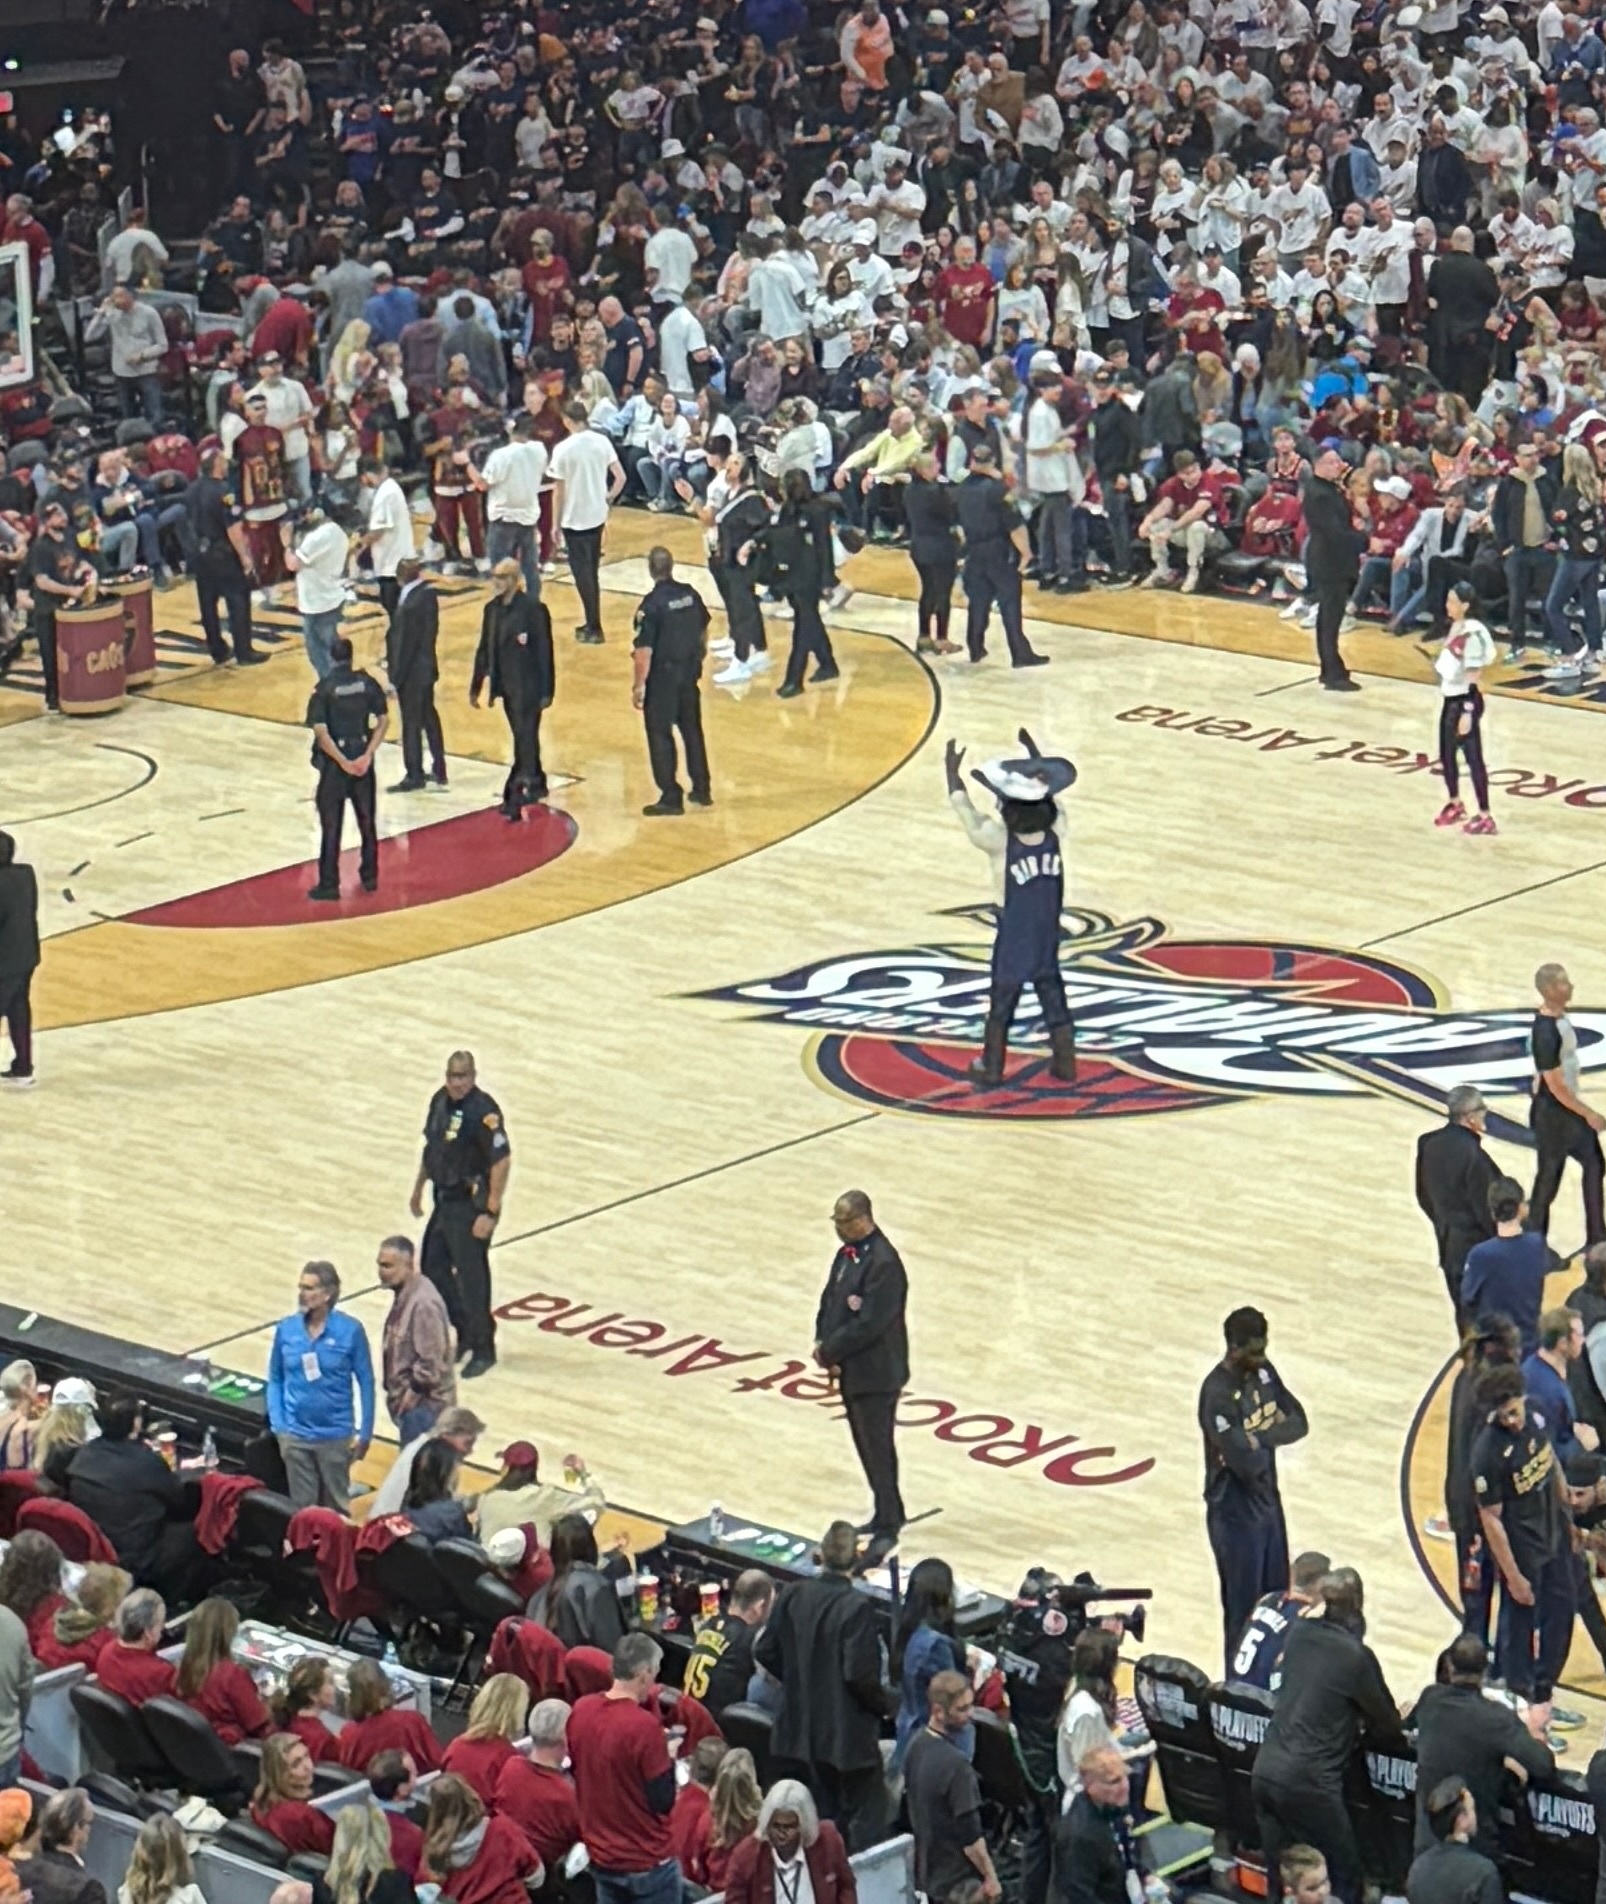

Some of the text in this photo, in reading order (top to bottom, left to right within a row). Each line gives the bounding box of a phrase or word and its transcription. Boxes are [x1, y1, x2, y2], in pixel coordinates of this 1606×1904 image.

[1115, 704, 1336, 752] Arena
[493, 1291, 774, 1376] Arena
[1233, 1630, 1266, 1675] 5
[1537, 1792, 1596, 1835] PLAYOFFS
